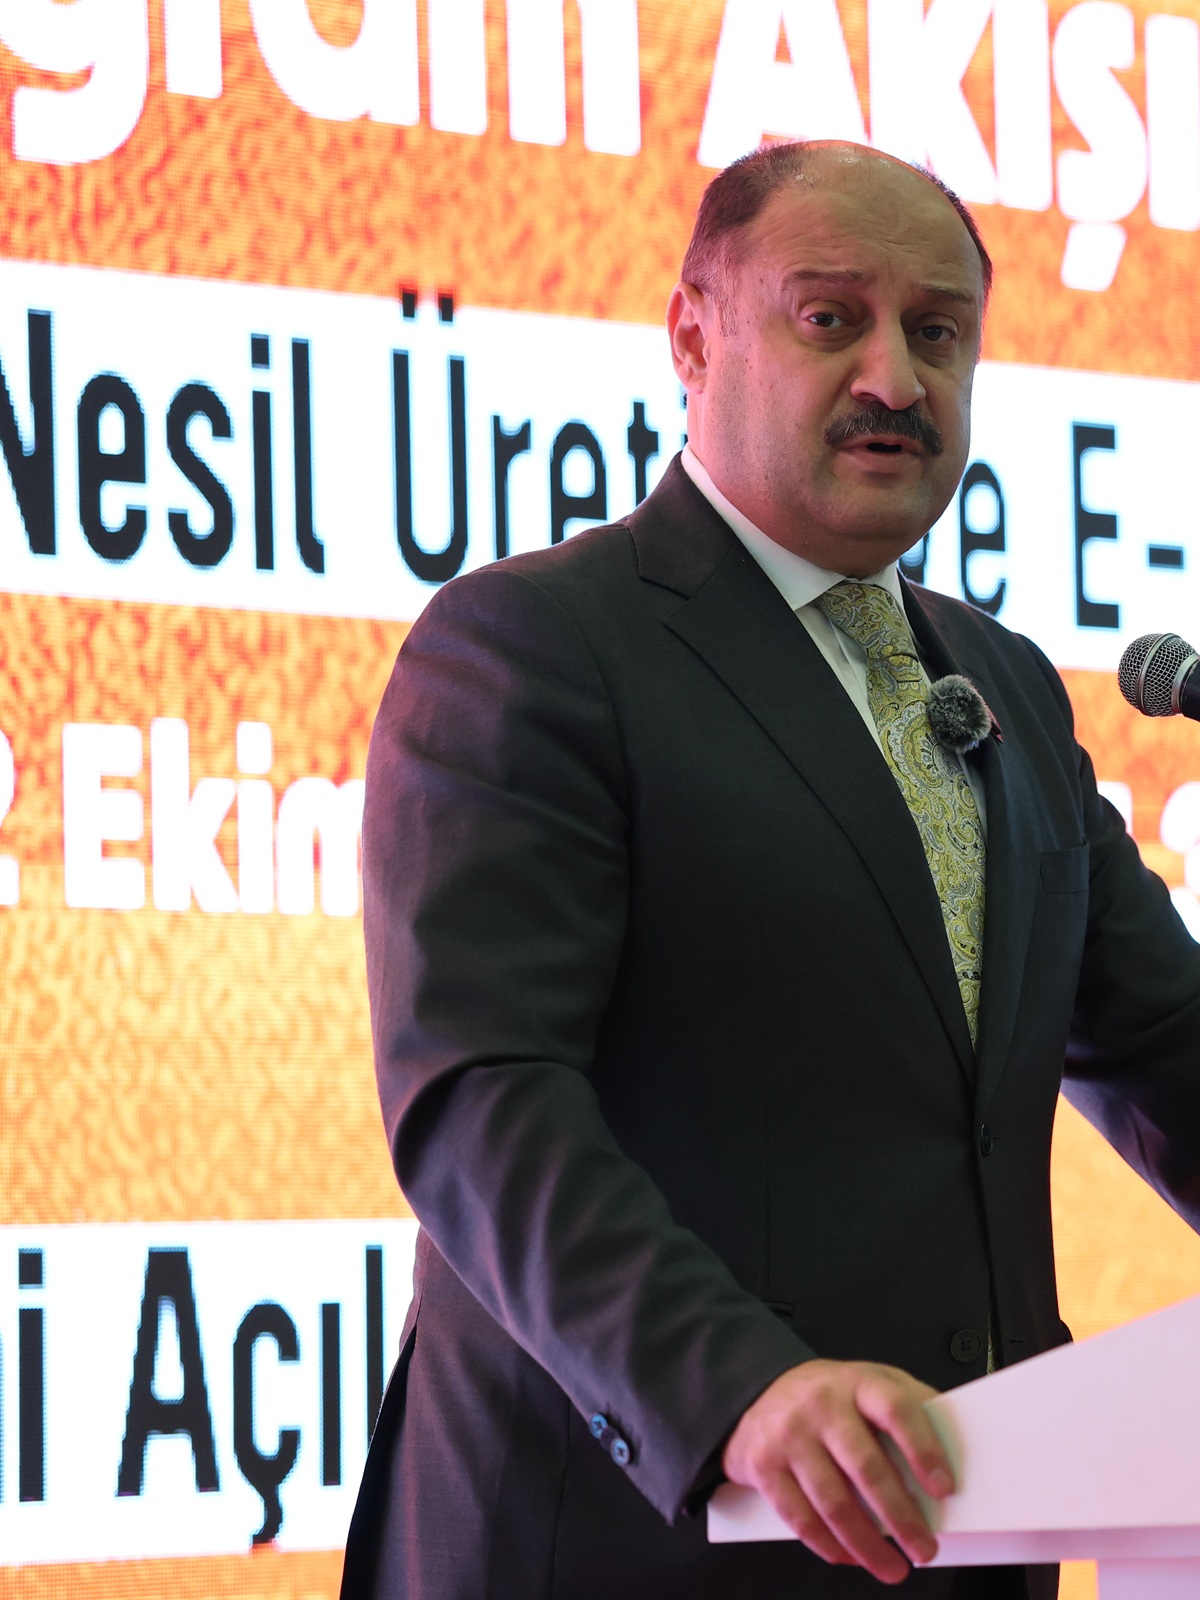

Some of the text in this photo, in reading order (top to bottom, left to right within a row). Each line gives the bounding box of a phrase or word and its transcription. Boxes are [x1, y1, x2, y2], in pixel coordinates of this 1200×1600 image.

[0, 308, 325, 575] Nesil
[392, 290, 688, 583] Üret
[62, 716, 366, 917] Ekim
